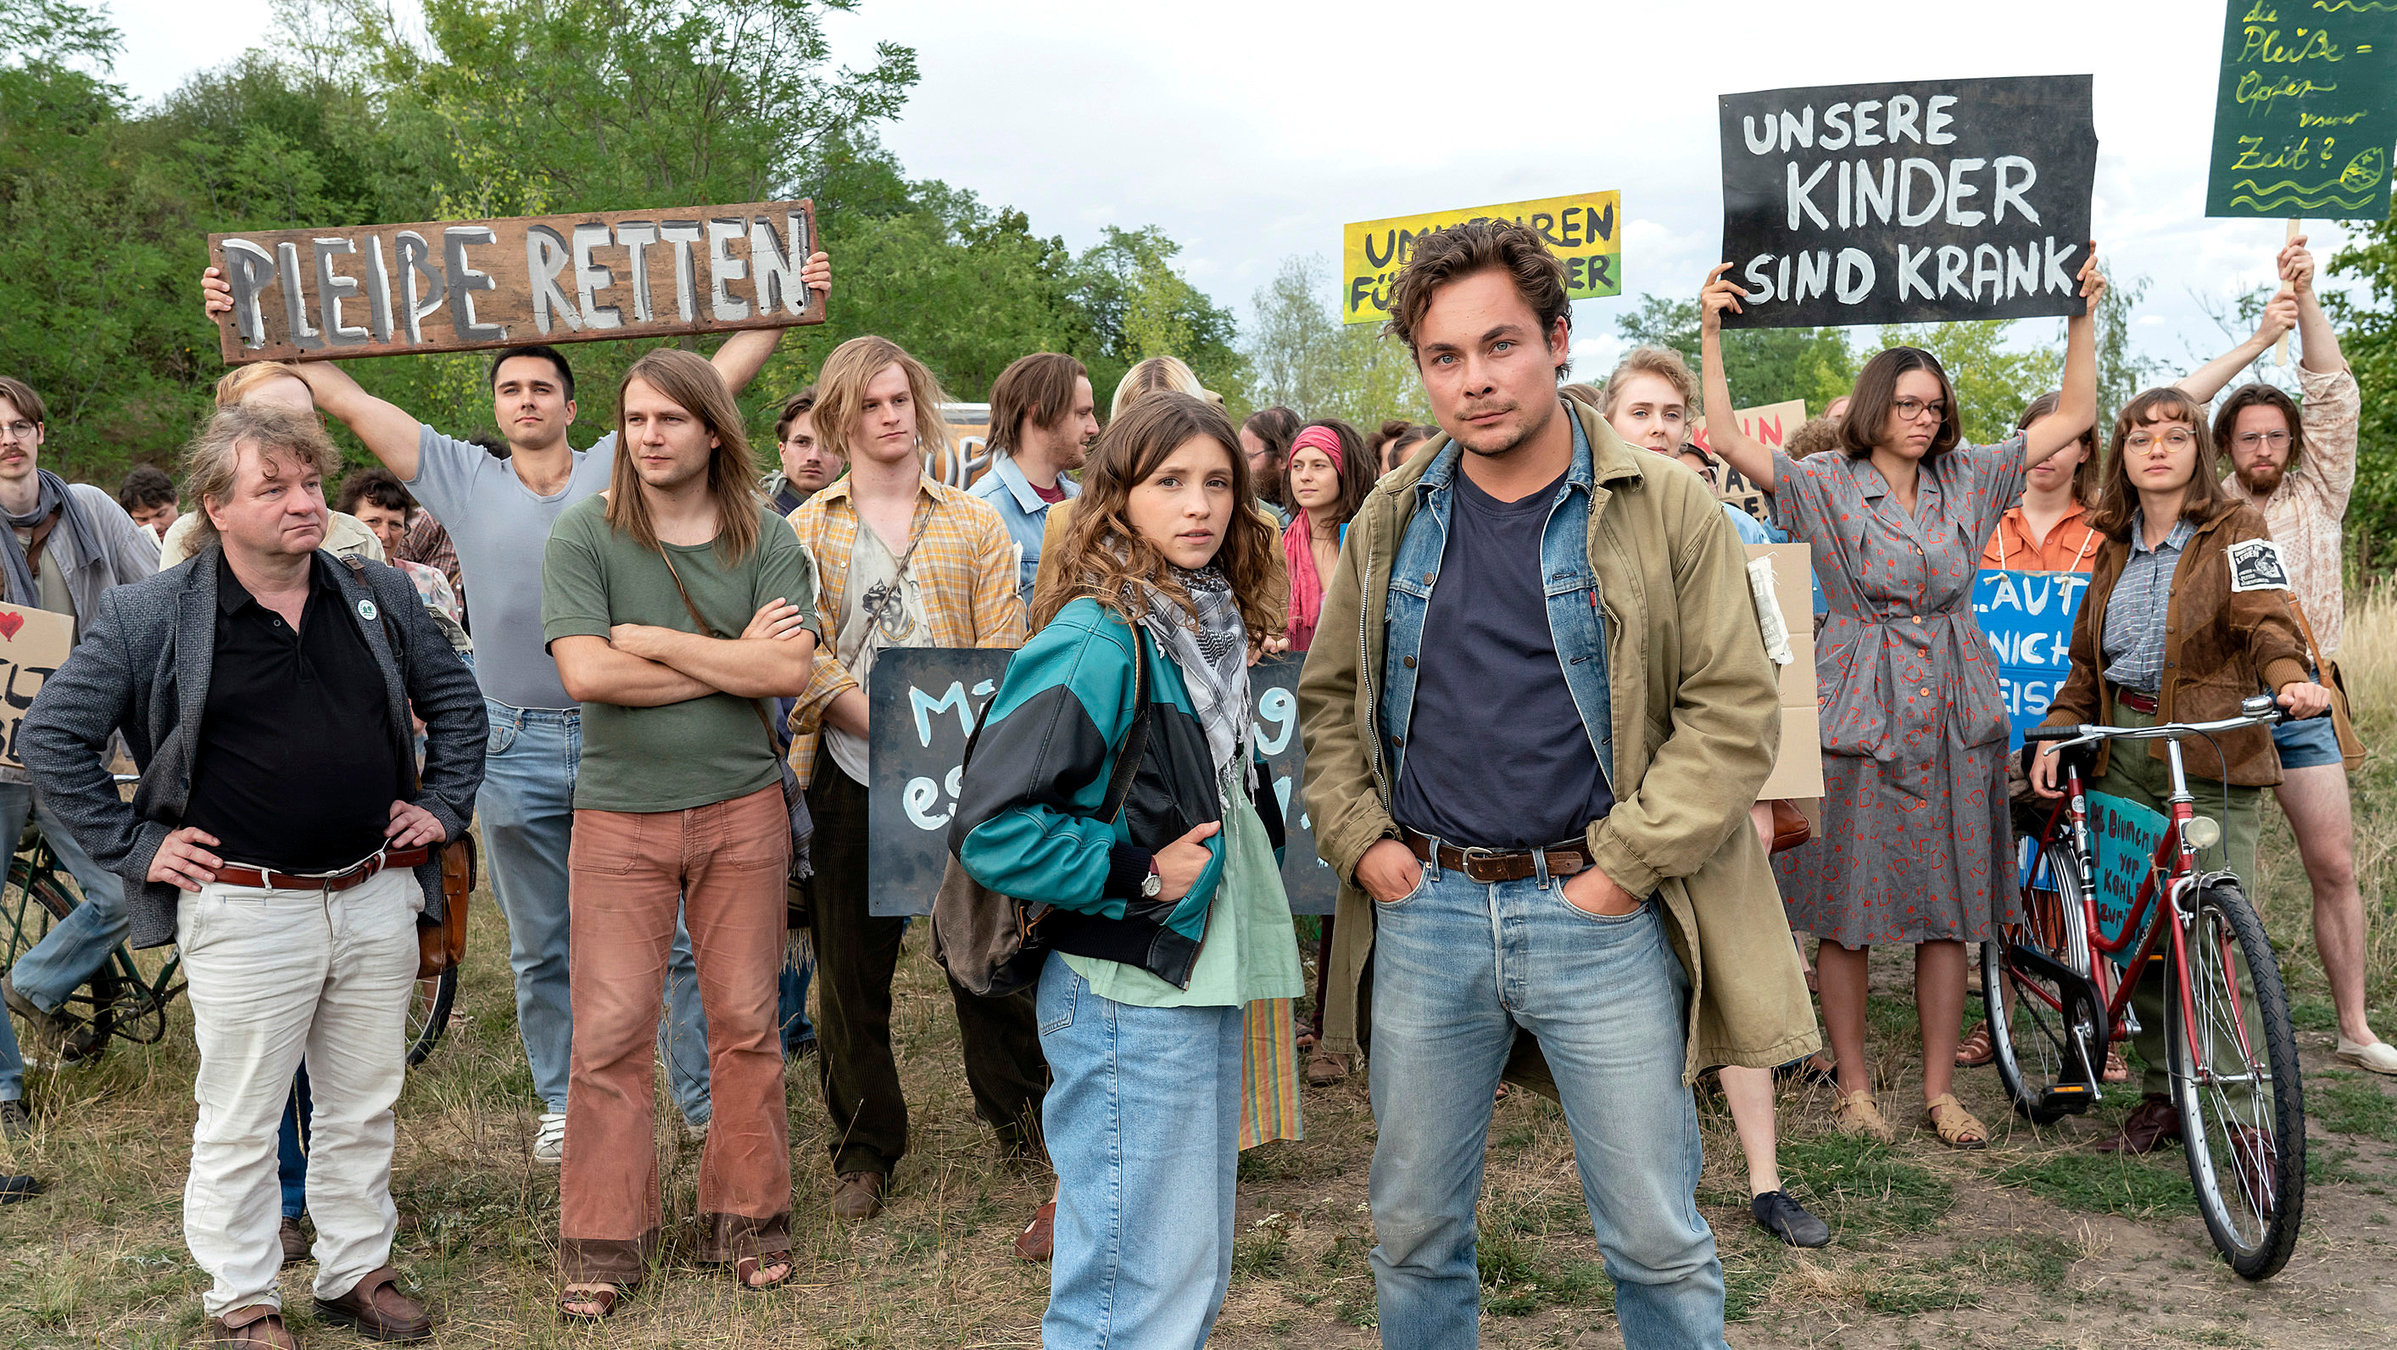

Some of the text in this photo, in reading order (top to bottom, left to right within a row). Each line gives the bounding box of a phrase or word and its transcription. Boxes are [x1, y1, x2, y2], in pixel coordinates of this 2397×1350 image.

[2243, 0, 2278, 22] die
[2237, 25, 2346, 62] Pleiße
[1743, 94, 1958, 155] UNSERE
[1787, 155, 2041, 231] KINDER
[1365, 201, 1614, 268] UMREN
[527, 208, 810, 336] RETTEN
[1351, 255, 1615, 313] FÜ ER
[1744, 236, 2078, 305] SIND KRANK
[1971, 576, 2090, 616] AUT
[1989, 629, 2074, 666] NICH
[1999, 678, 2067, 716] EIS
